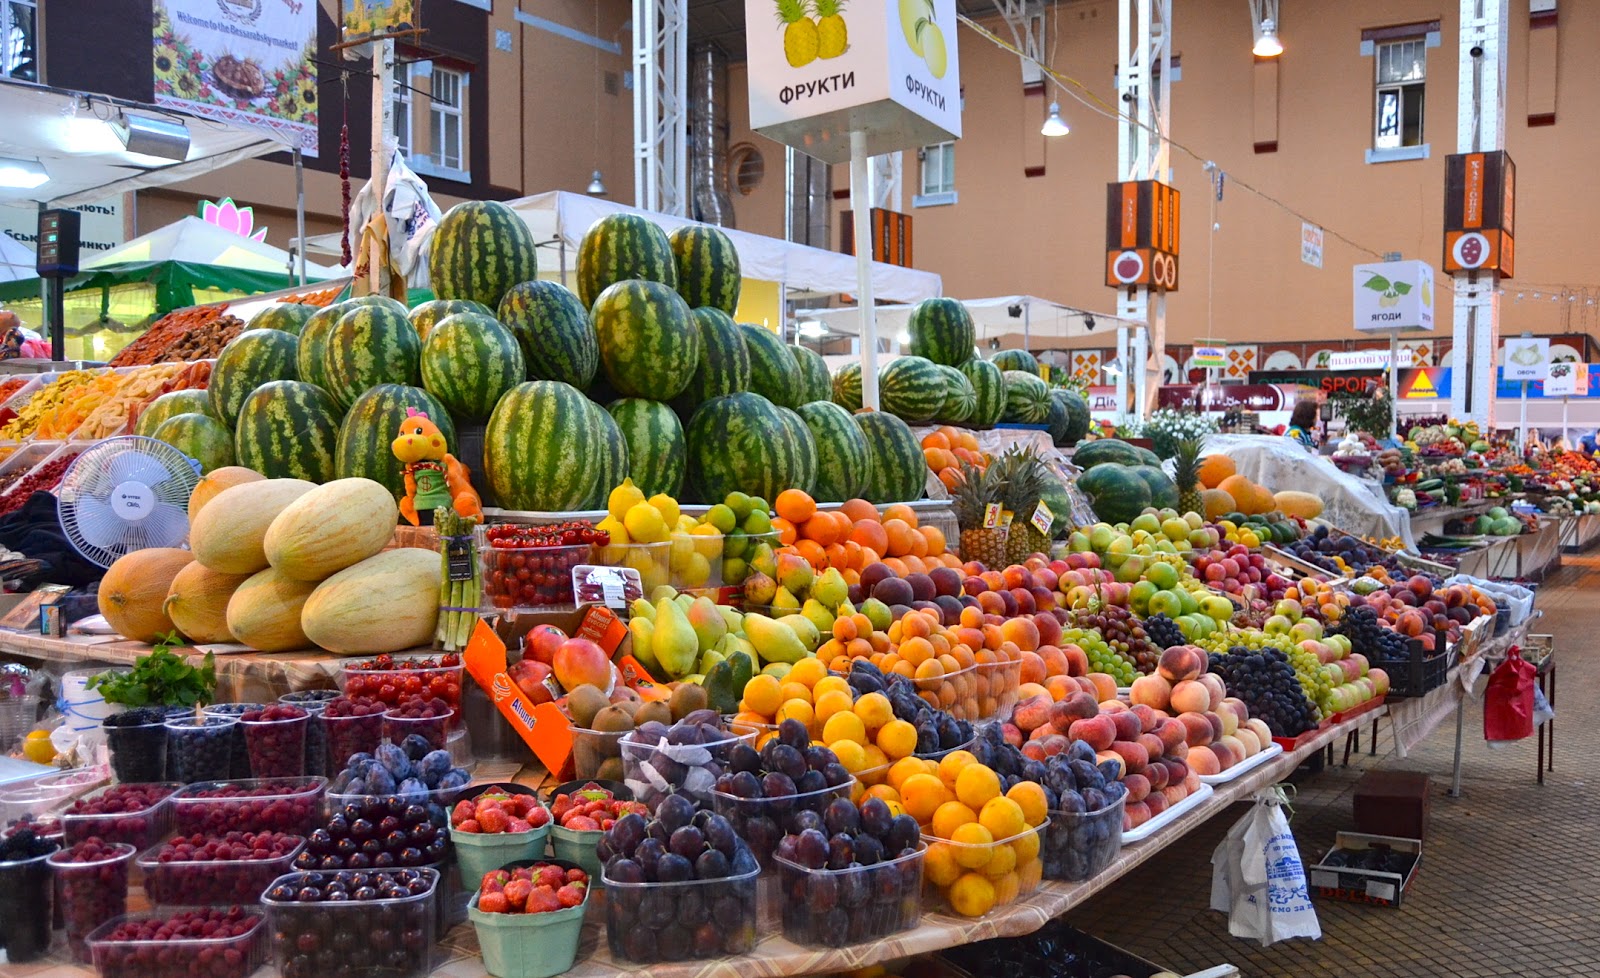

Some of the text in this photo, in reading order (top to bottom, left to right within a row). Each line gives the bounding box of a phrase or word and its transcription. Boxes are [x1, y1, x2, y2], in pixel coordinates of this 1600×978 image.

[177, 11, 298, 51] Welcome to the Bessarabsky market!
[779, 71, 855, 105] ФРУКТИ
[905, 74, 946, 112] ФРУКТИ
[987, 506, 998, 526] Dole
